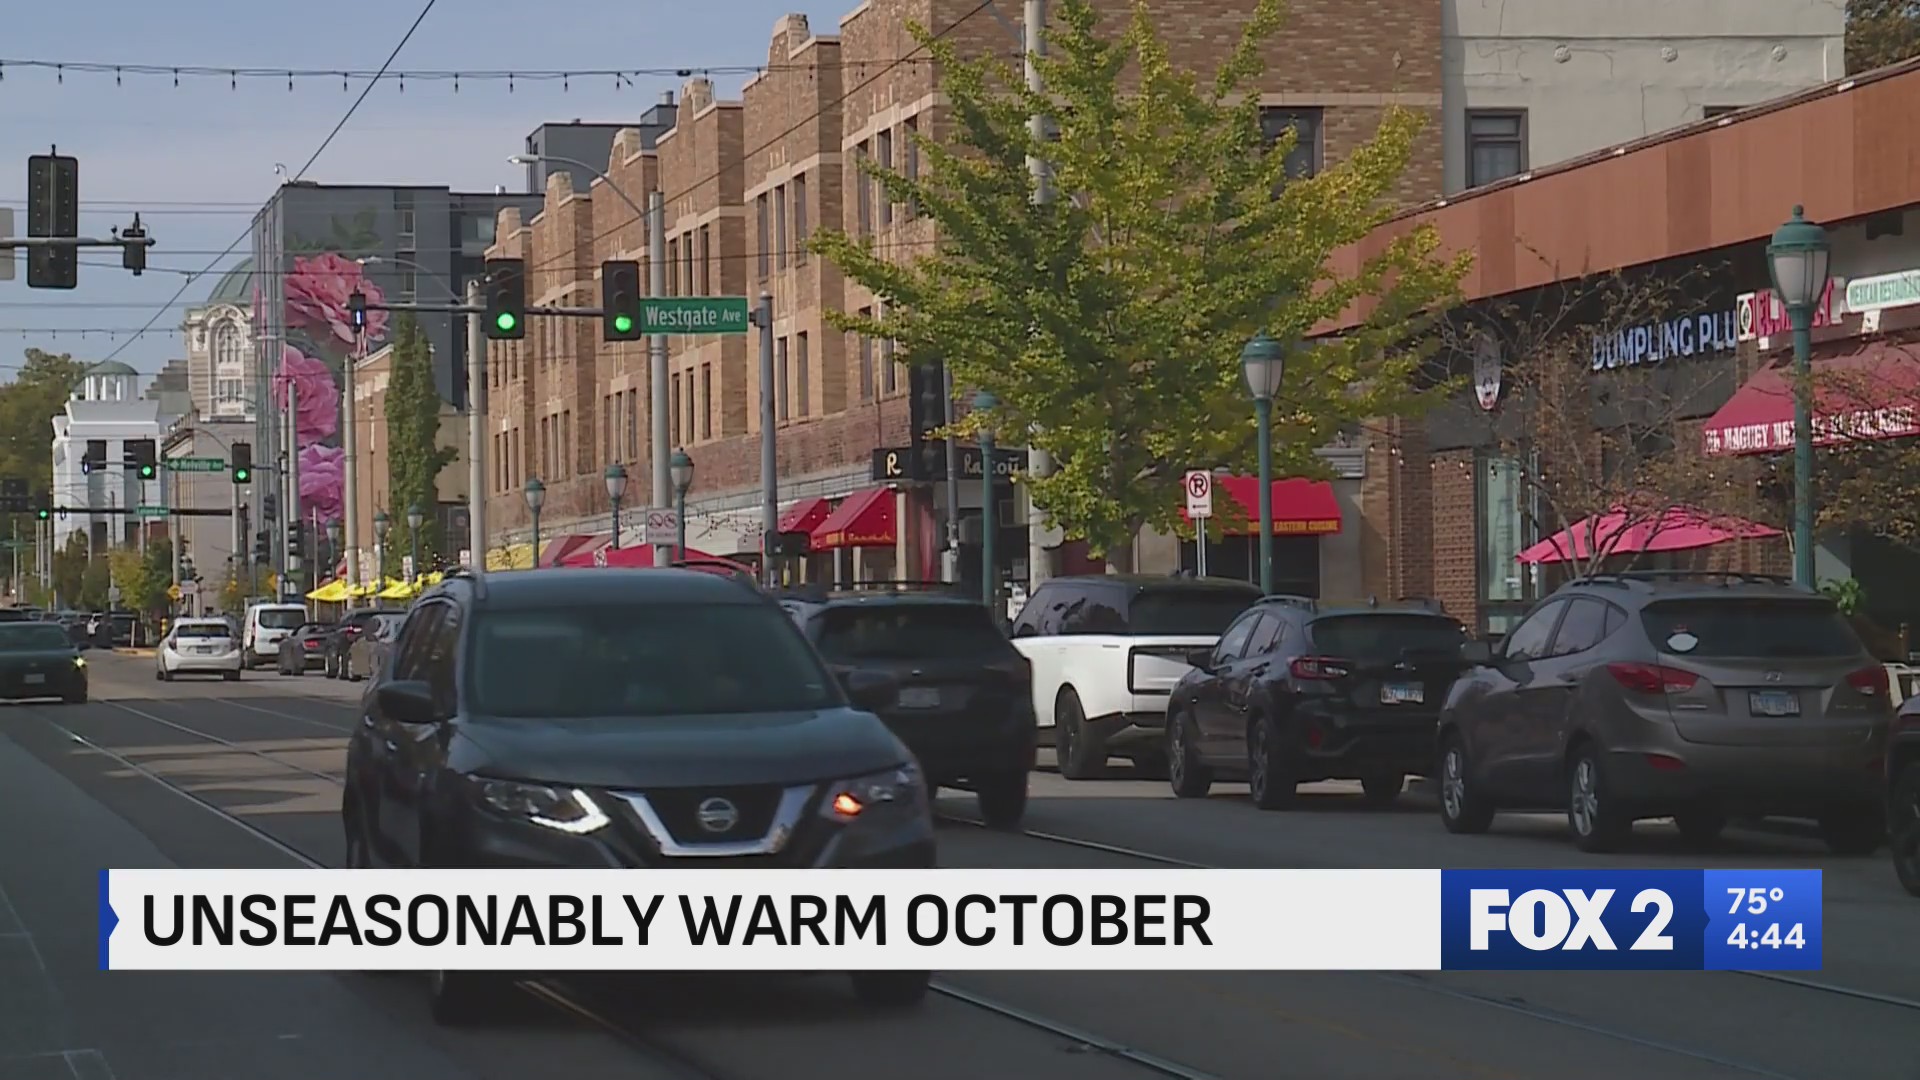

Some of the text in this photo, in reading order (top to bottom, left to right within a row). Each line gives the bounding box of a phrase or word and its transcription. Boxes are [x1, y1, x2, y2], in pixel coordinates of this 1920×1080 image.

[645, 305, 742, 332] Westgate Ave
[1592, 316, 1694, 370] DUMPLING
[1723, 423, 1769, 451] MAGUEY
[886, 452, 902, 476] R
[1274, 520, 1307, 532] EASTERN
[1308, 519, 1338, 531] CUISINE
